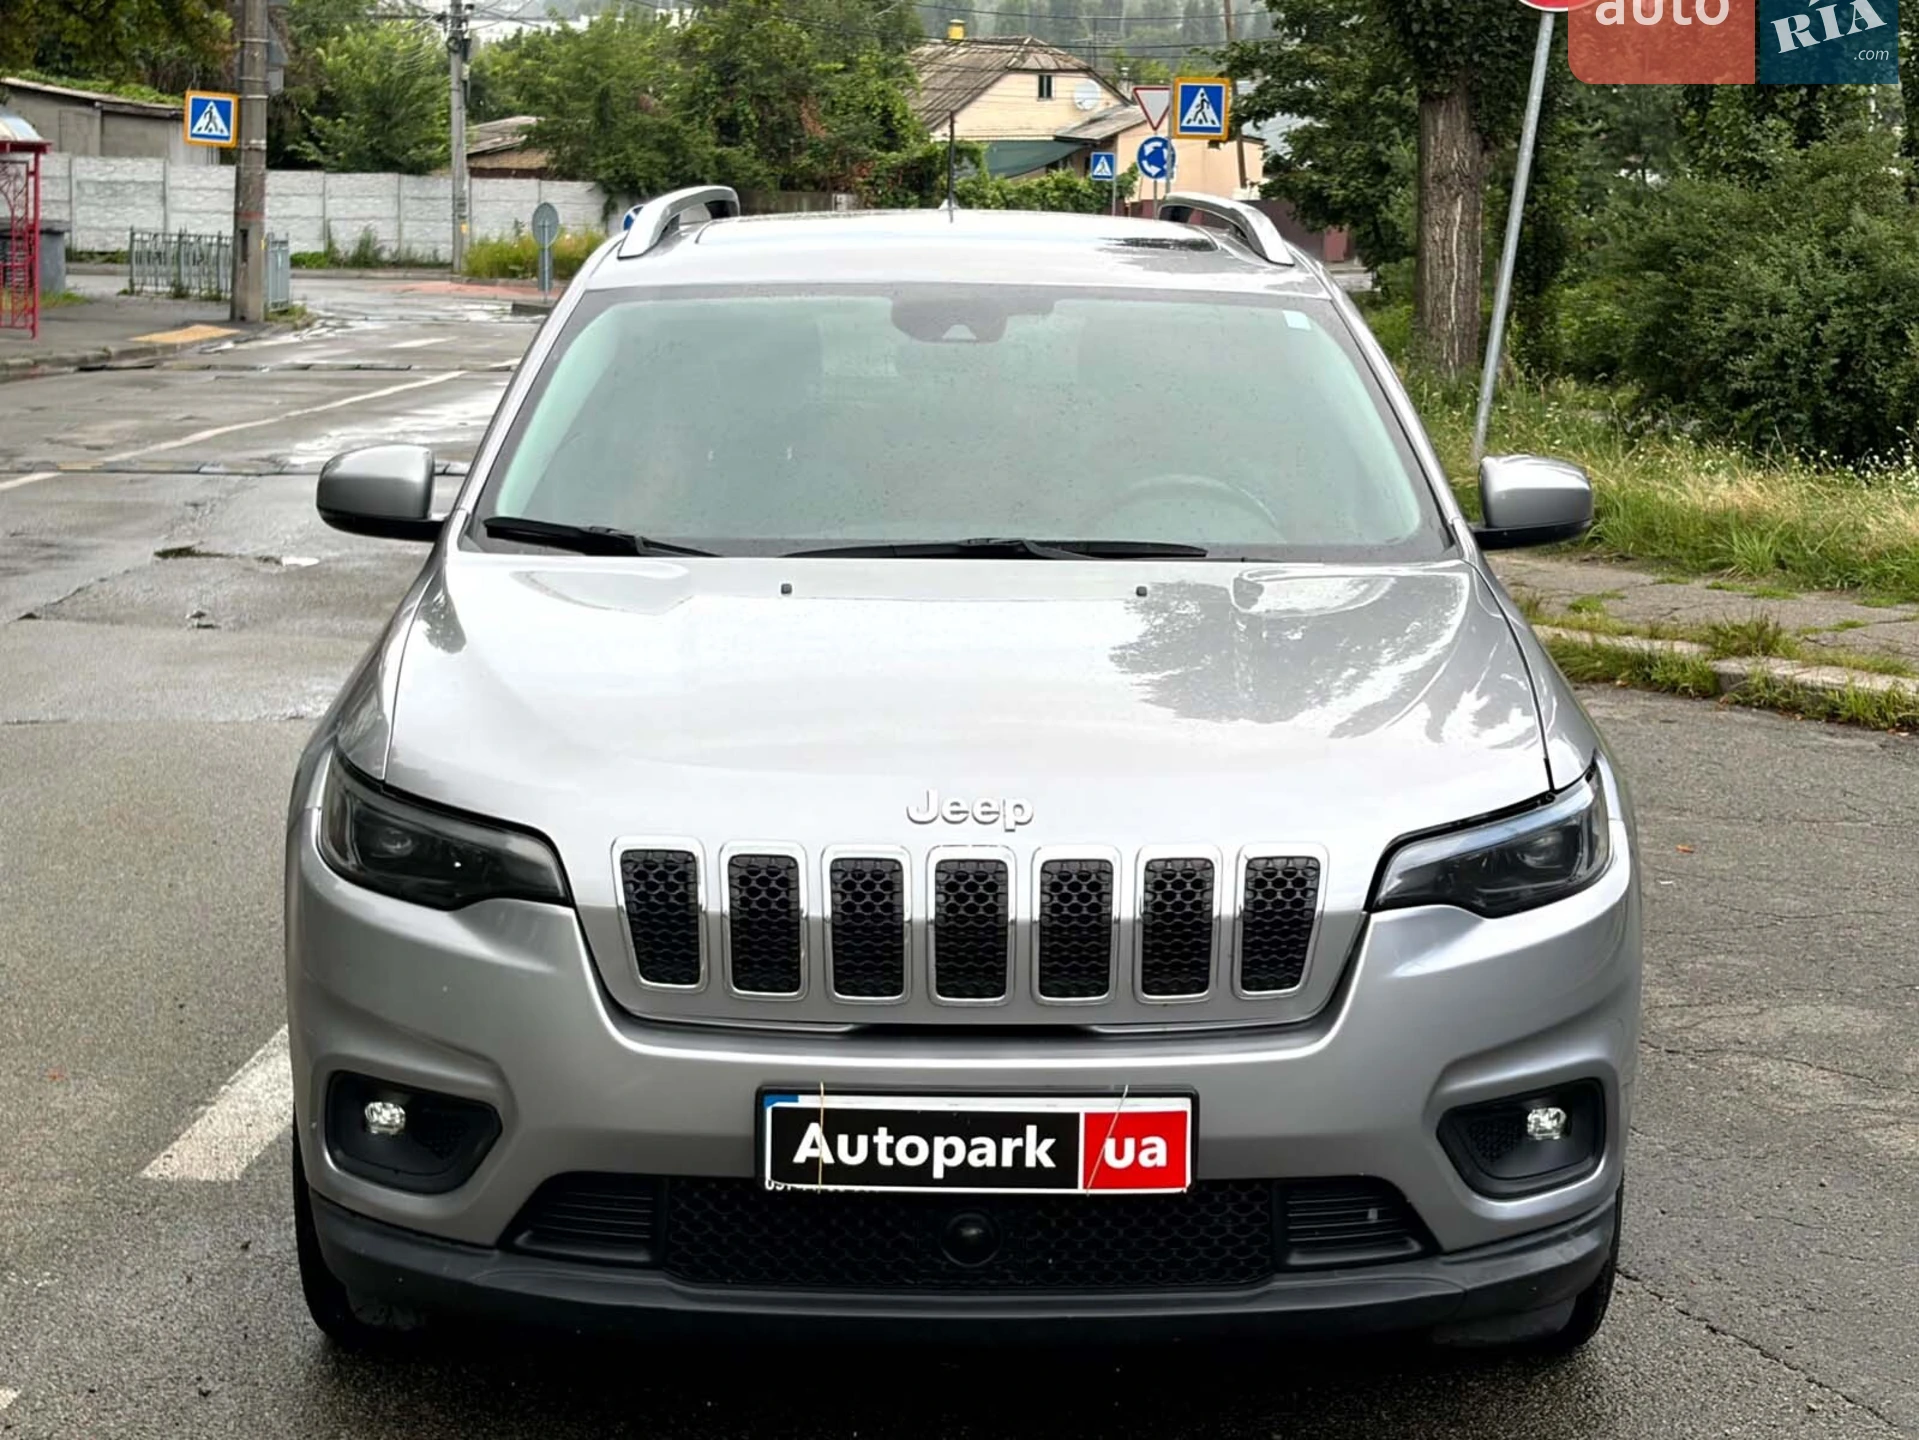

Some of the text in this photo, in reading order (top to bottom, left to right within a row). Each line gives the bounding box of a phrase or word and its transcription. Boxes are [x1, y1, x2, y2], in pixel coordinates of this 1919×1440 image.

[906, 788, 1034, 832] Jeep
[792, 1122, 1168, 1179] Autopark ua
